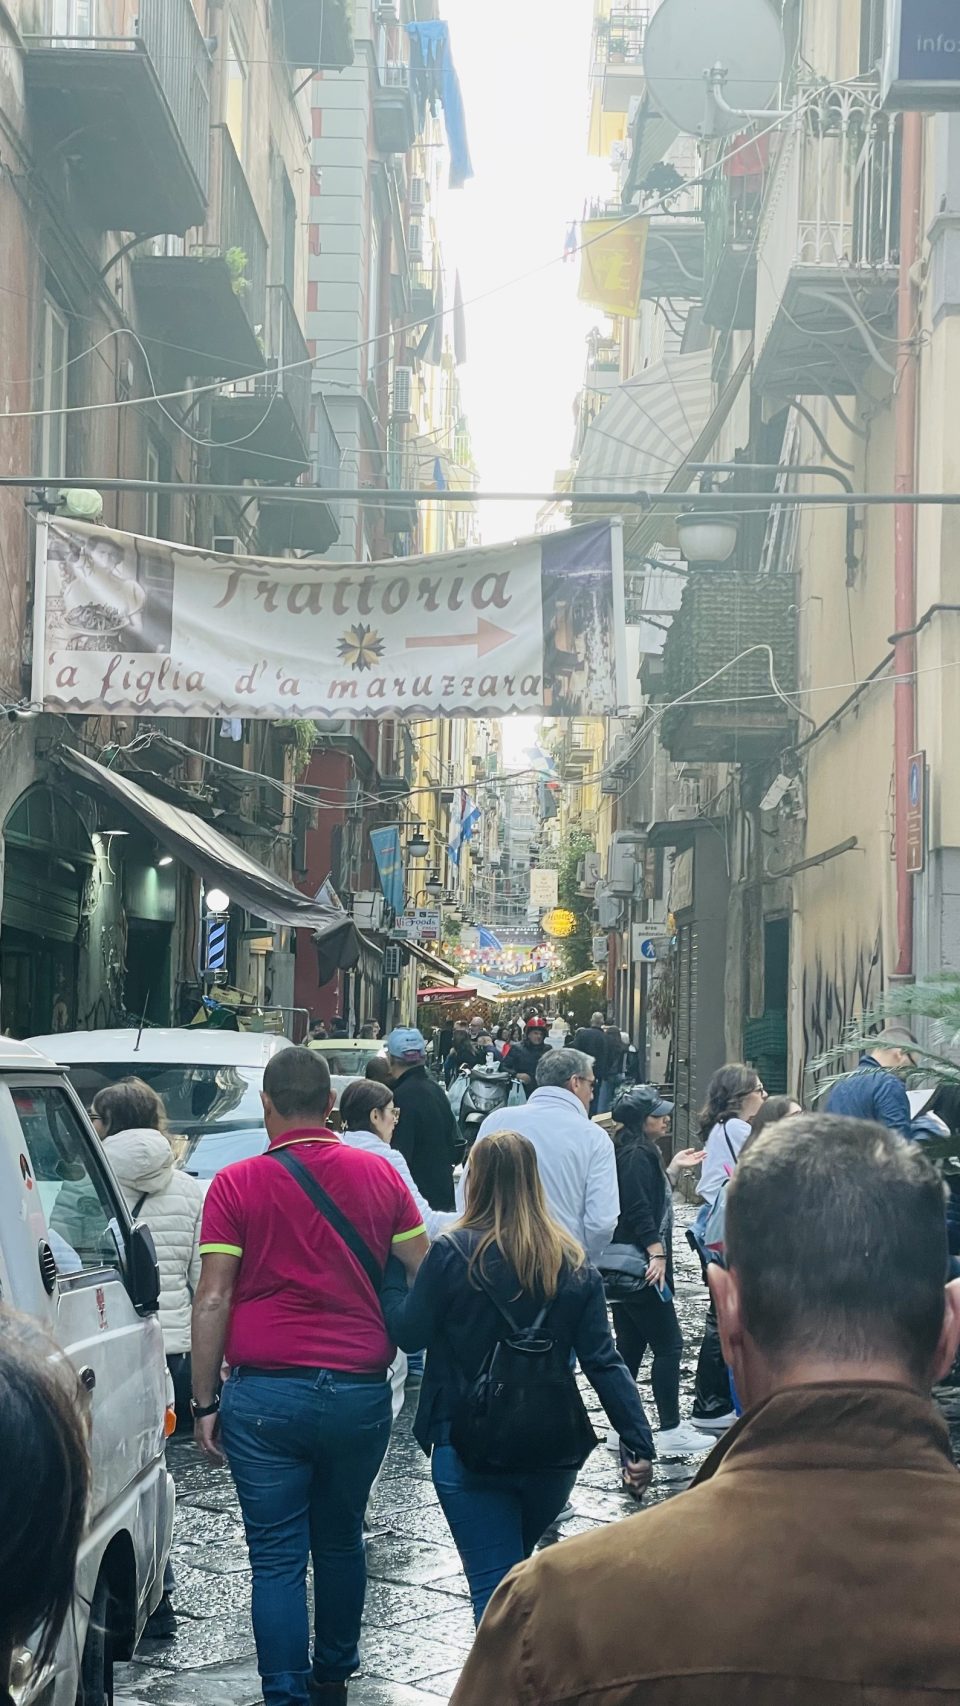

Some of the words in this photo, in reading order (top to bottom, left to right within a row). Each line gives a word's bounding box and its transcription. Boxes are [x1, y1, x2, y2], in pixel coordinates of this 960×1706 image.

[212, 564, 512, 616] Trattoria
[101, 654, 206, 703] figlia
[327, 674, 541, 699] maruzzara
[405, 917, 436, 926] Foods
